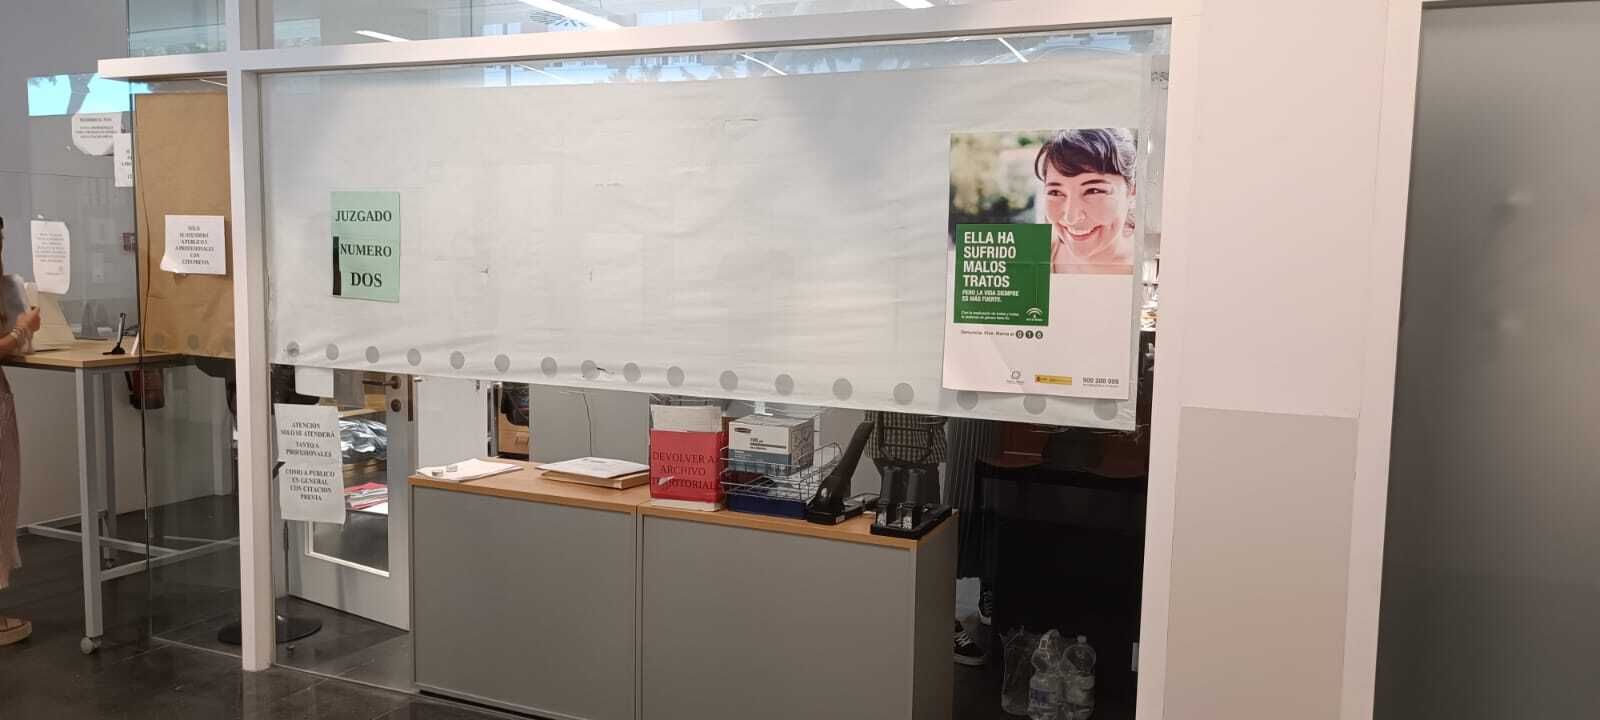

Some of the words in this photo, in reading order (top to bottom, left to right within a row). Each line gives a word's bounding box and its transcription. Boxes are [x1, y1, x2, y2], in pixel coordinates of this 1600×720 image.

[335, 209, 392, 222] JUZGADO
[964, 231, 994, 244] ELLA
[997, 231, 1015, 244] HA
[340, 243, 392, 258] NUMERO
[963, 245, 1017, 259] SUFRIDO
[963, 260, 1007, 273] MALOS
[350, 271, 382, 288] DOS
[962, 274, 1010, 288] TRATOS
[286, 449, 332, 458] PROFESIONALES
[652, 451, 705, 464] DEVOLVER
[661, 464, 706, 476] ARCHIVO
[300, 478, 328, 486] GENERAL
[301, 493, 322, 501] PREVIA
